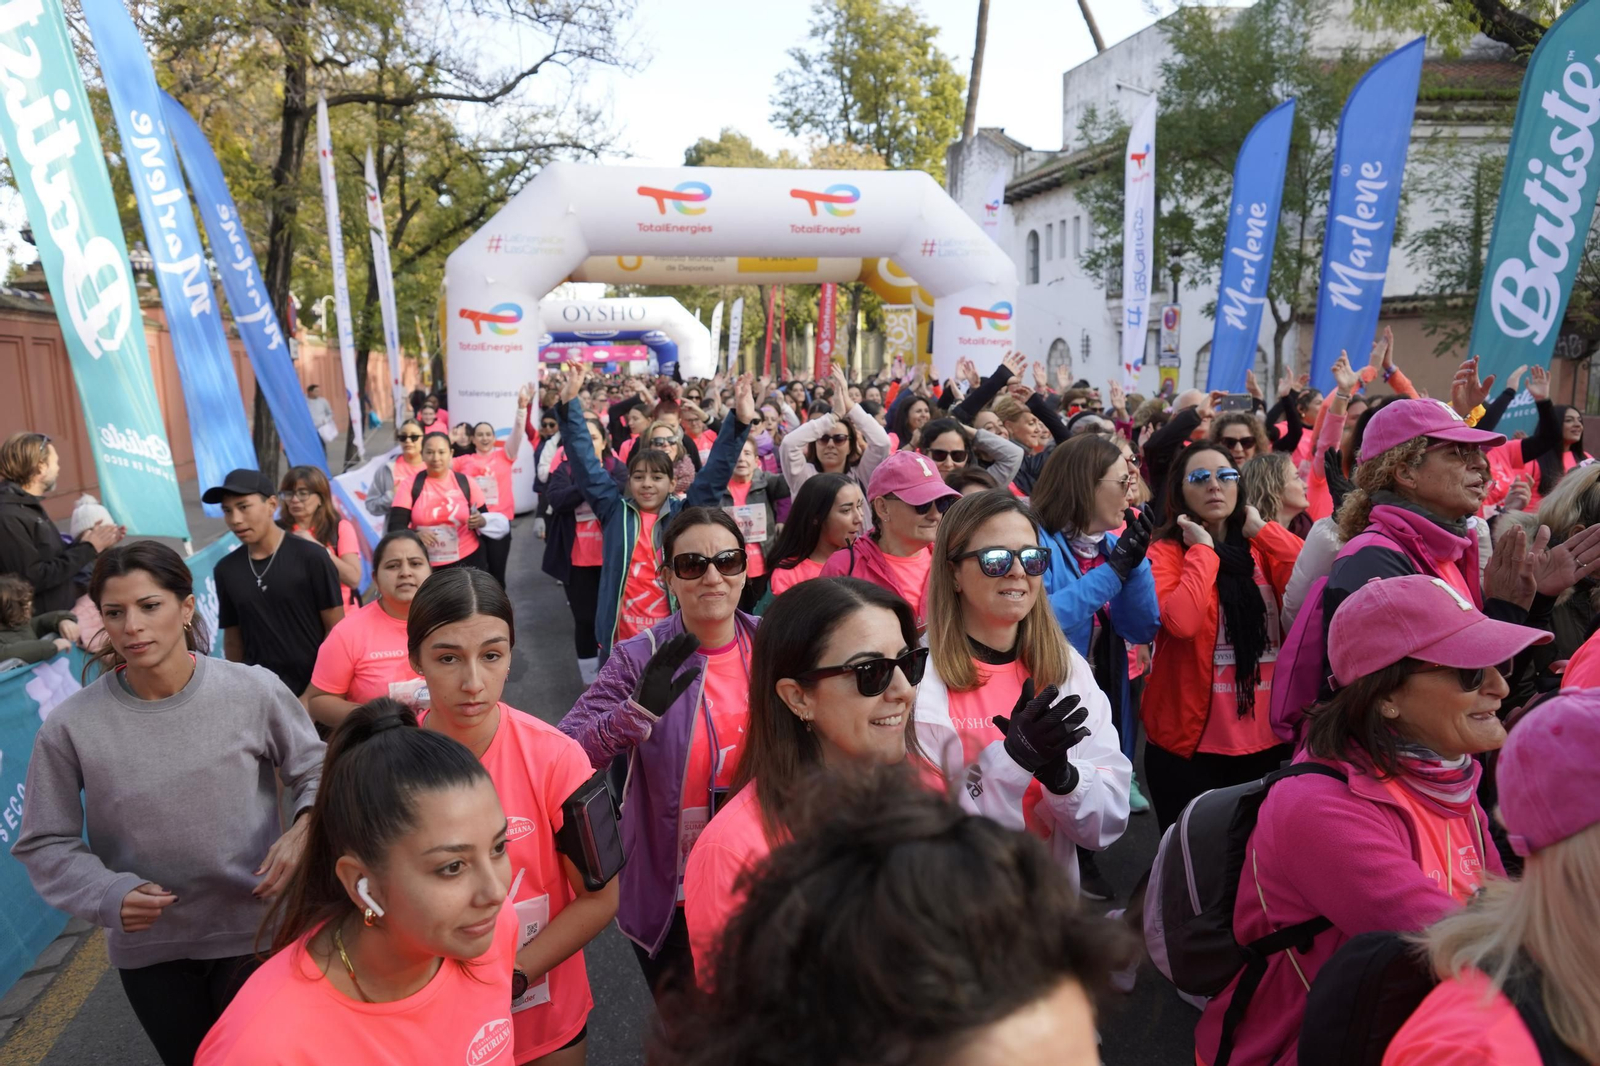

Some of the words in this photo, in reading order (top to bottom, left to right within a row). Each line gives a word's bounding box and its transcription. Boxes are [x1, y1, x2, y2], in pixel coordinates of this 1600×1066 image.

[1491, 54, 1600, 346] Batiste
[637, 222, 713, 235] TotalEnergies
[789, 224, 861, 236] TotalEnergies
[1327, 160, 1388, 311] Marlene
[1222, 201, 1268, 331] Marlene
[562, 305, 646, 323] OYSHO
[821, 283, 833, 339] Santander
[458, 341, 523, 353] TotalEnergies
[958, 337, 1013, 348] TotalEnergie
[370, 649, 404, 659] OYSHO
[1212, 682, 1232, 693] RERA
[504, 825, 532, 836] URIANA
[471, 1027, 510, 1065] ASTURIAN
